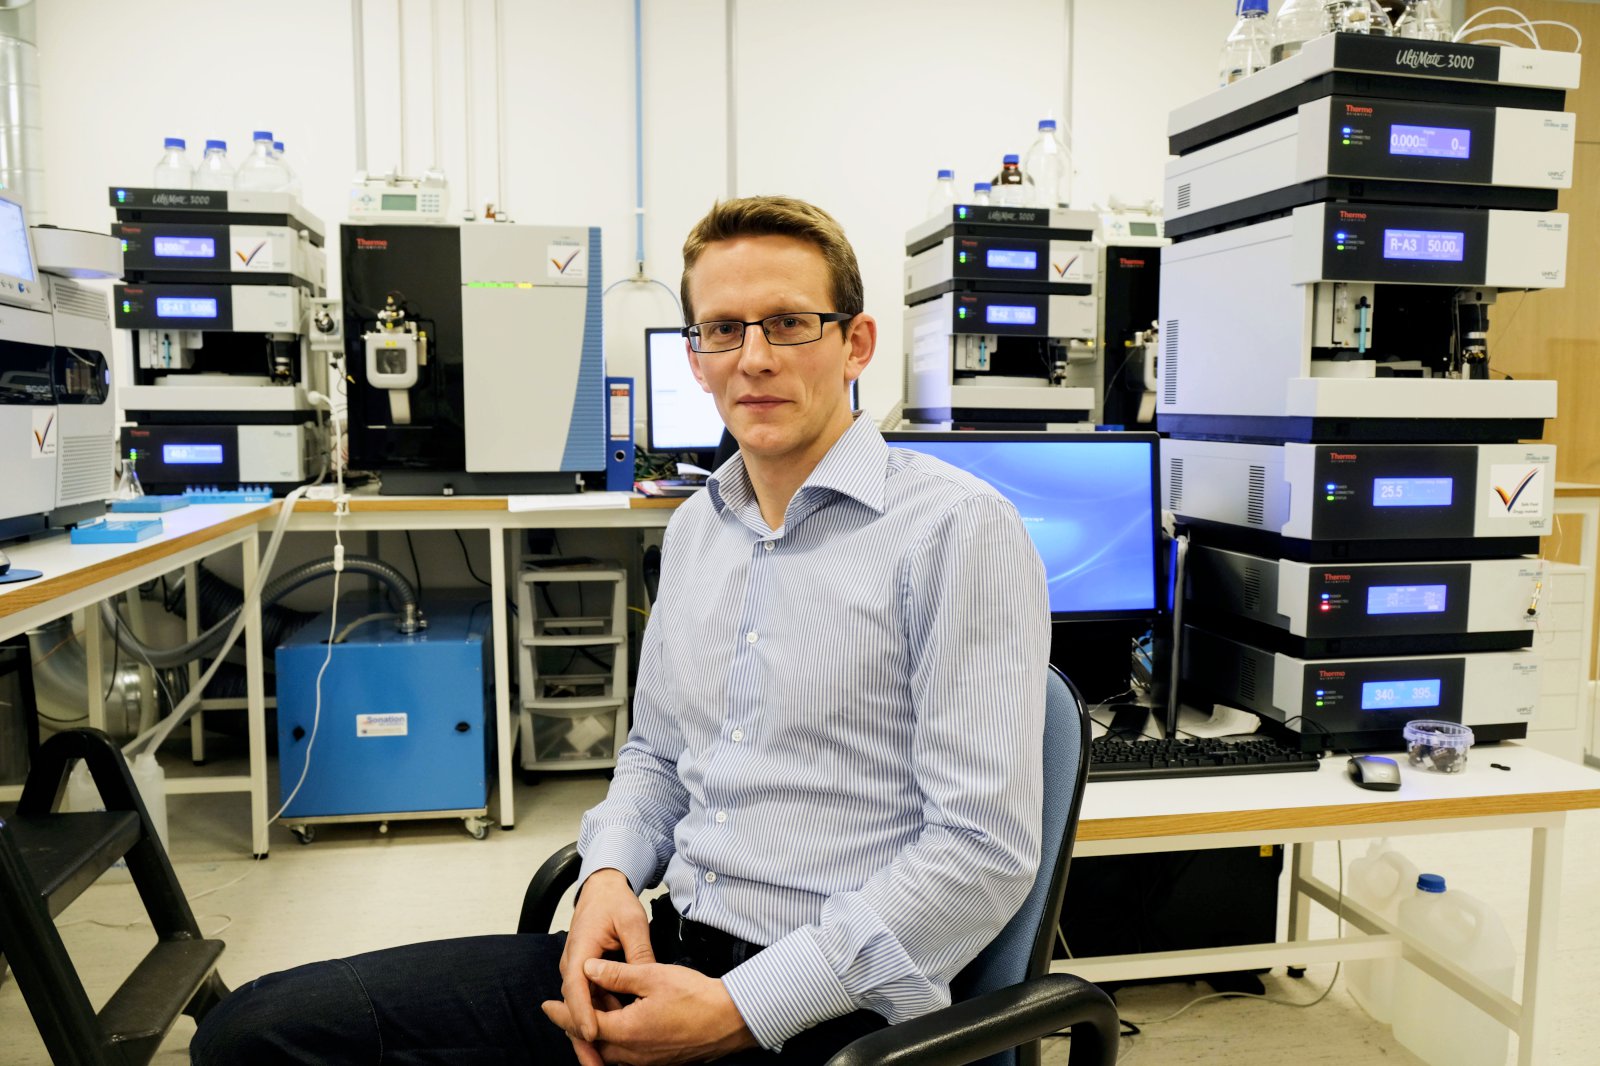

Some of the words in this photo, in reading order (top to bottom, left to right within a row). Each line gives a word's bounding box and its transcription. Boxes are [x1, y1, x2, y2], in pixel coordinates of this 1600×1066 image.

[1396, 49, 1446, 69] UltiMate
[1447, 54, 1475, 70] 3000
[1345, 104, 1373, 113] Thermo
[1390, 133, 1420, 148] 0.000
[1451, 137, 1459, 151] 0
[1339, 210, 1367, 219] Thermo
[356, 238, 388, 246] Thermo
[1390, 237, 1417, 252] R-A3
[1427, 239, 1456, 253] 50.00
[1119, 257, 1145, 265] Thermo
[1329, 452, 1357, 460] Thermo
[1381, 485, 1404, 499] 25.5
[1319, 670, 1346, 678] Thermo
[1374, 688, 1394, 701] 340
[1411, 687, 1431, 699] 395
